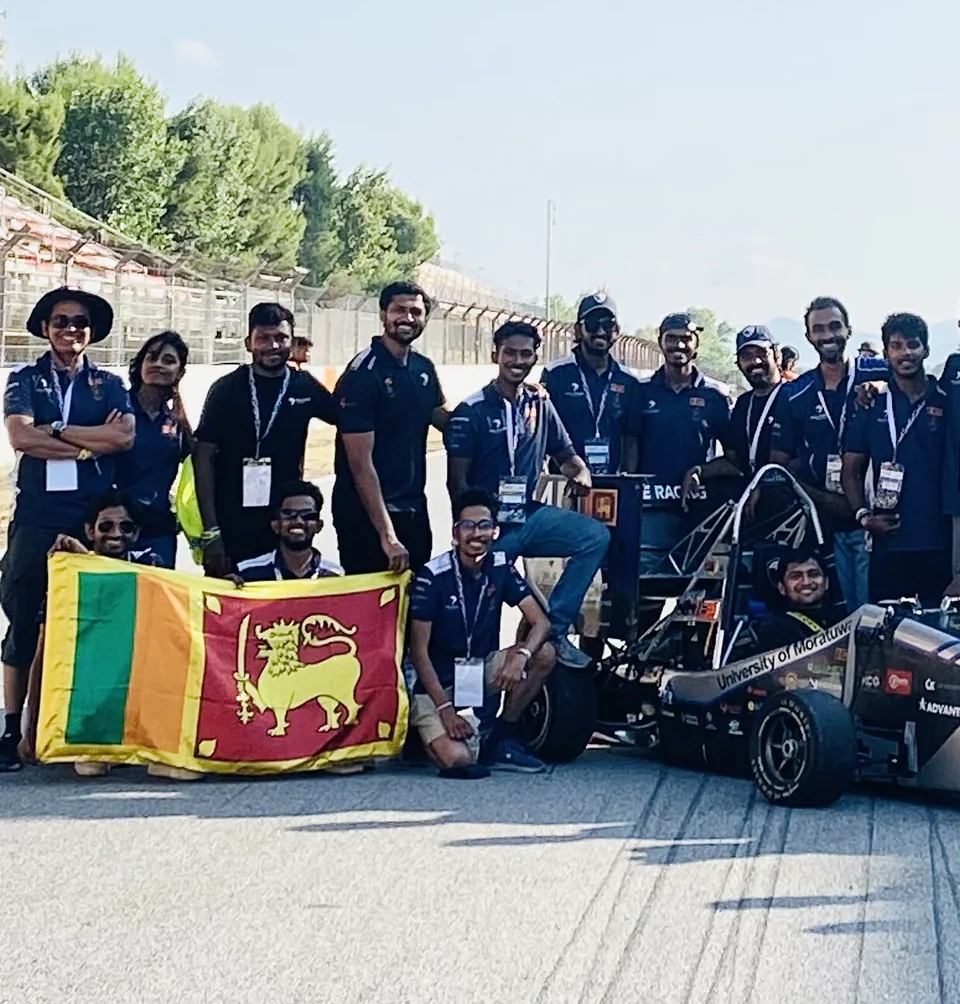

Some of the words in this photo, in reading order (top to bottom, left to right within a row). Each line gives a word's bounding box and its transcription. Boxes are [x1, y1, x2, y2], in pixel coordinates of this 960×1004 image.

[717, 654, 776, 690] University
[778, 647, 792, 663] of
[794, 617, 853, 656] Moratuwa
